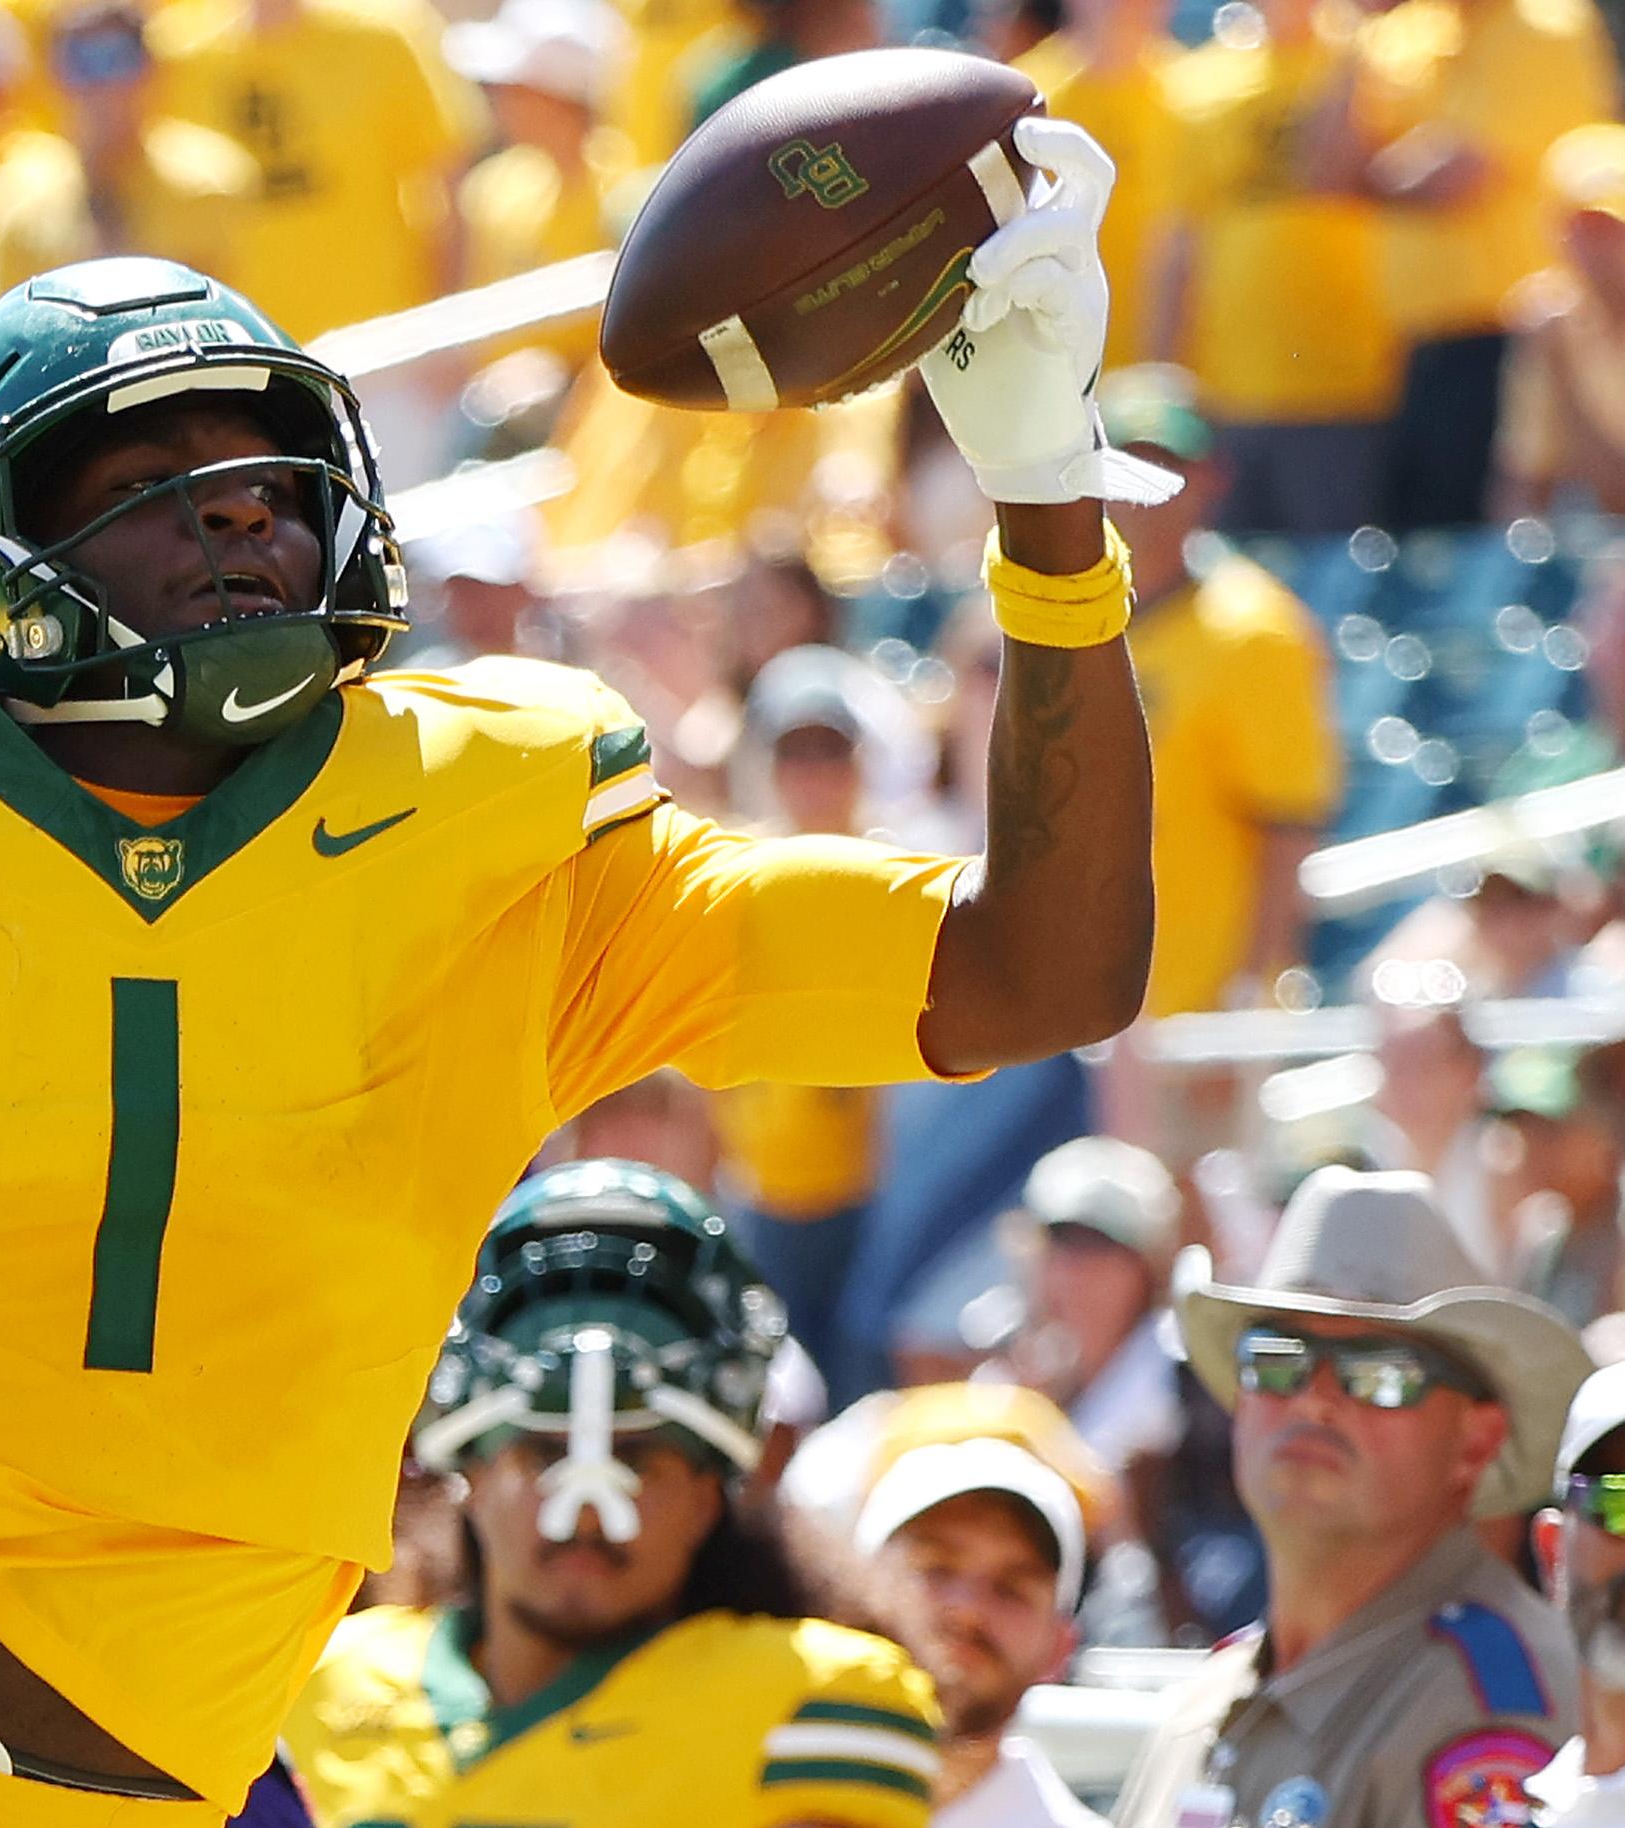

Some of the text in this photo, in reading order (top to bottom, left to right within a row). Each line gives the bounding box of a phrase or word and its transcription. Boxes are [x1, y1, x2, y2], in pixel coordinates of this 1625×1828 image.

[135, 322, 233, 351] BAYLOR
[944, 330, 977, 372] RS
[83, 976, 181, 1374] 1
